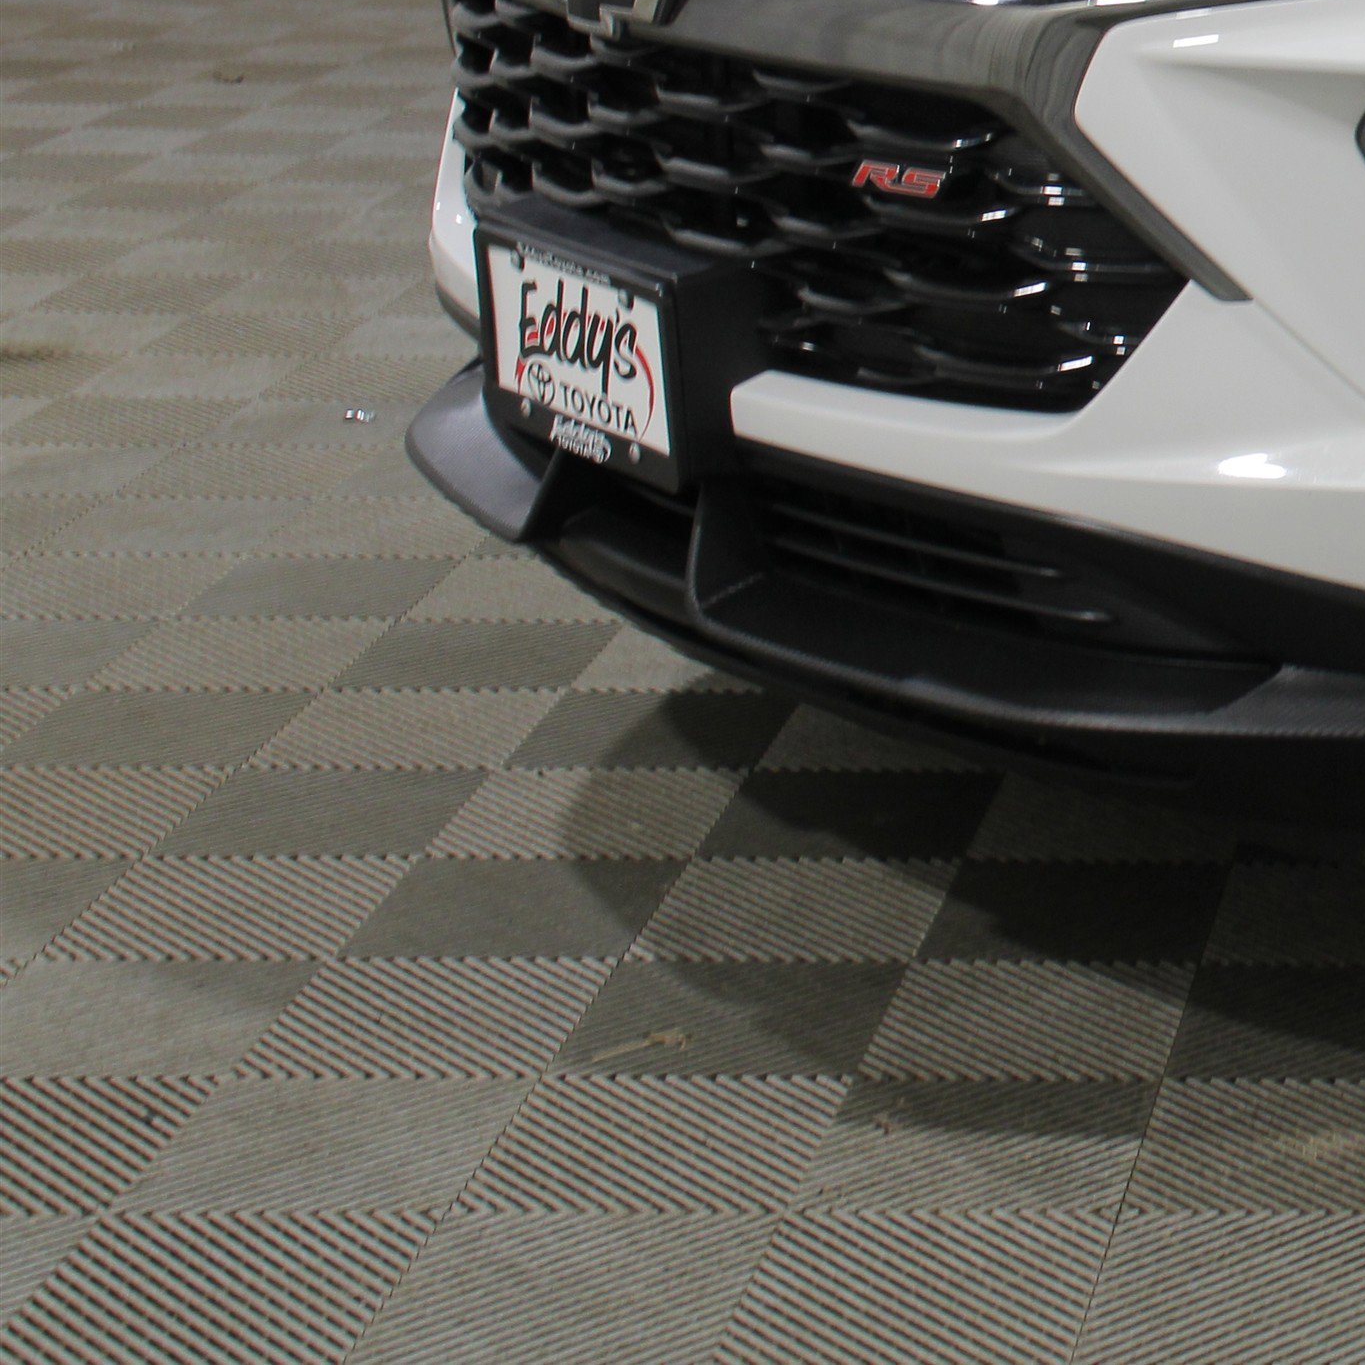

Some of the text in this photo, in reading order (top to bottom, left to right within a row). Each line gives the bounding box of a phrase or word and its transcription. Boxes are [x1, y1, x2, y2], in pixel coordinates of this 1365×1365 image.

[852, 159, 946, 199] RS
[519, 278, 638, 398] Eddy's
[559, 382, 638, 436] TOYOTA
